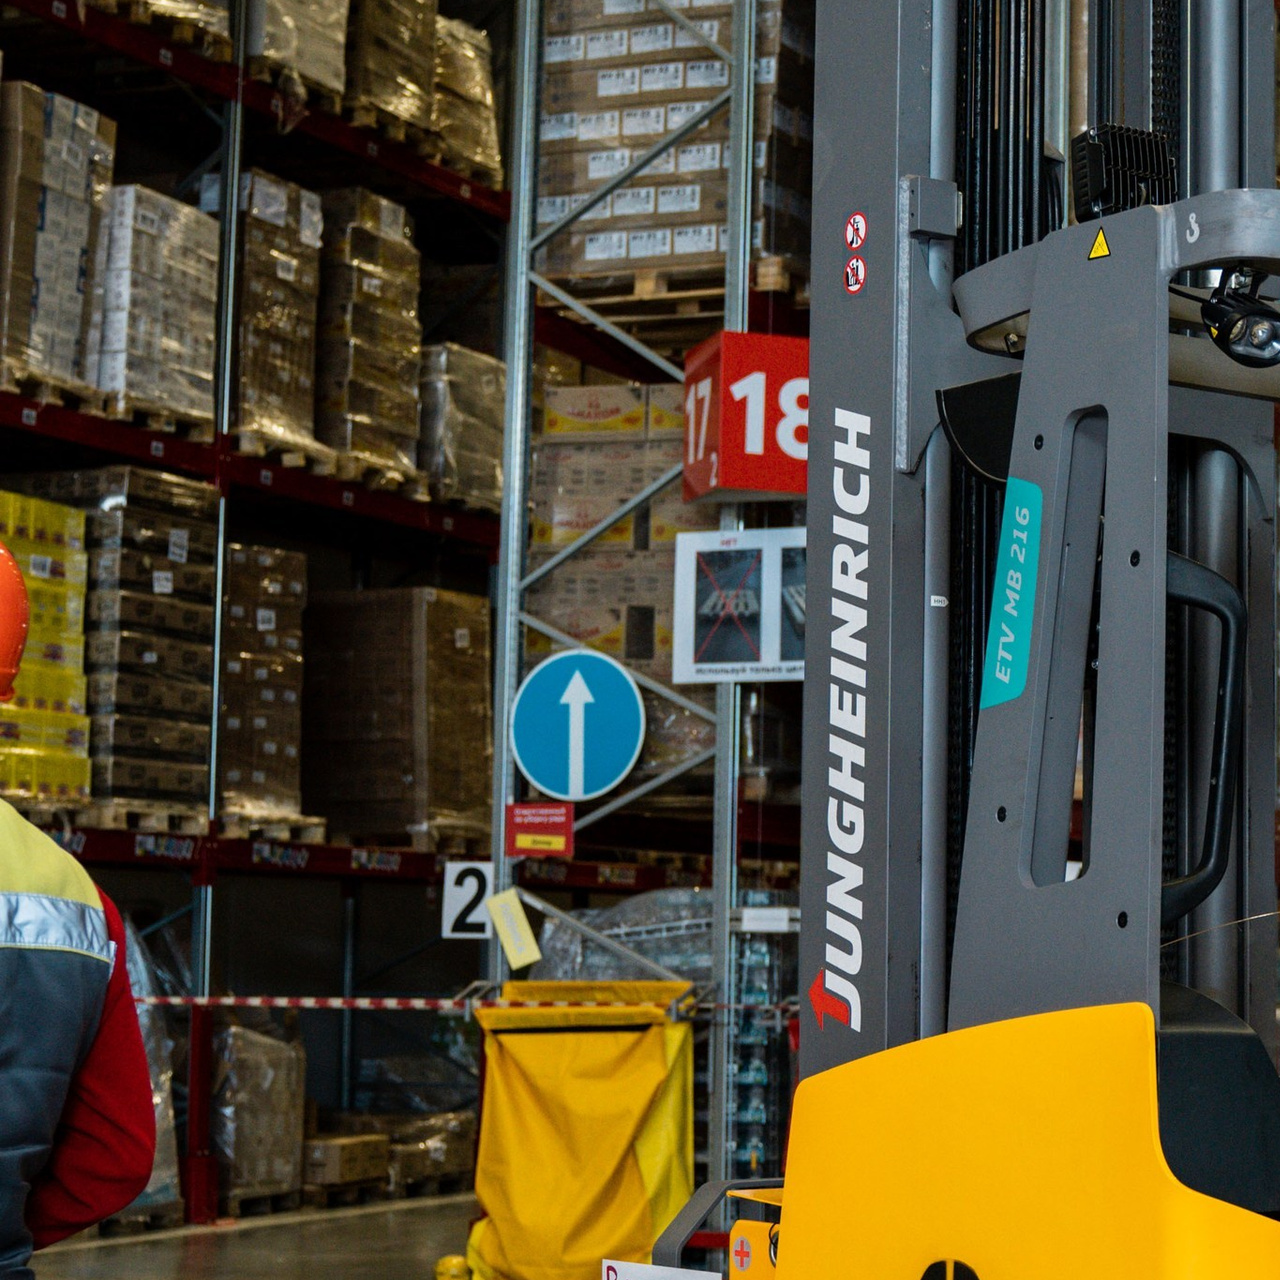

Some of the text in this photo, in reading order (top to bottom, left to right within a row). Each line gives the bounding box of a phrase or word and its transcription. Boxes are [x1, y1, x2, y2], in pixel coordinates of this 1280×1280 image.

[685, 376, 712, 465] 17
[730, 371, 809, 461] 18
[709, 452, 718, 488] 2
[995, 506, 1030, 685] ETV MB 216
[824, 407, 871, 1033] JUNGHEINRICH
[451, 867, 487, 934] 2
